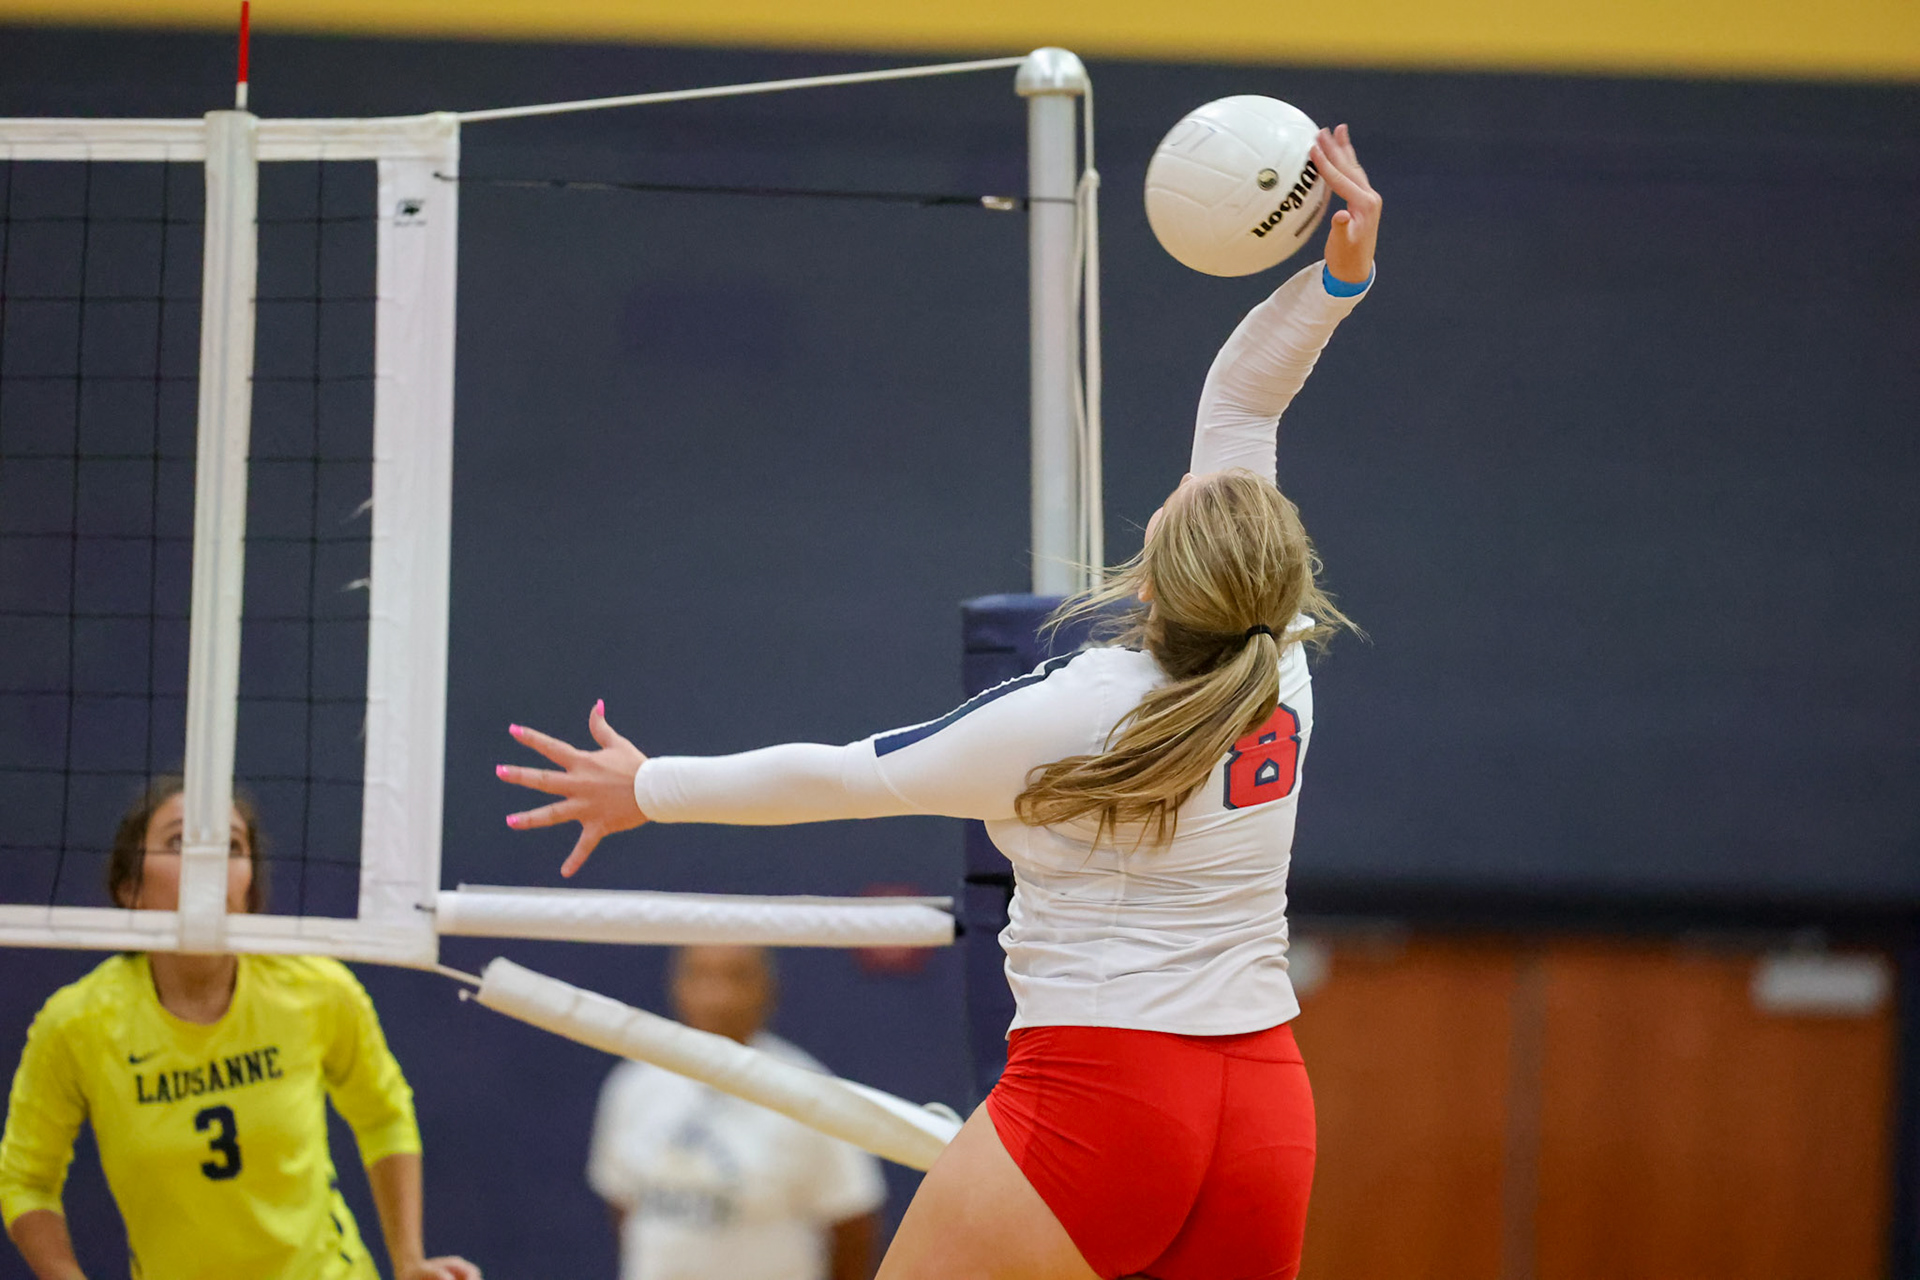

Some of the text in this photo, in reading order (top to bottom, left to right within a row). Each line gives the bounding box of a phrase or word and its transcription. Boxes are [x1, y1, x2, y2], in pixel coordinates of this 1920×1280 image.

[1251, 160, 1319, 238] Wilson
[1223, 702, 1302, 810] 8
[135, 1046, 283, 1104] LAUSANNE
[194, 1105, 242, 1180] 3
